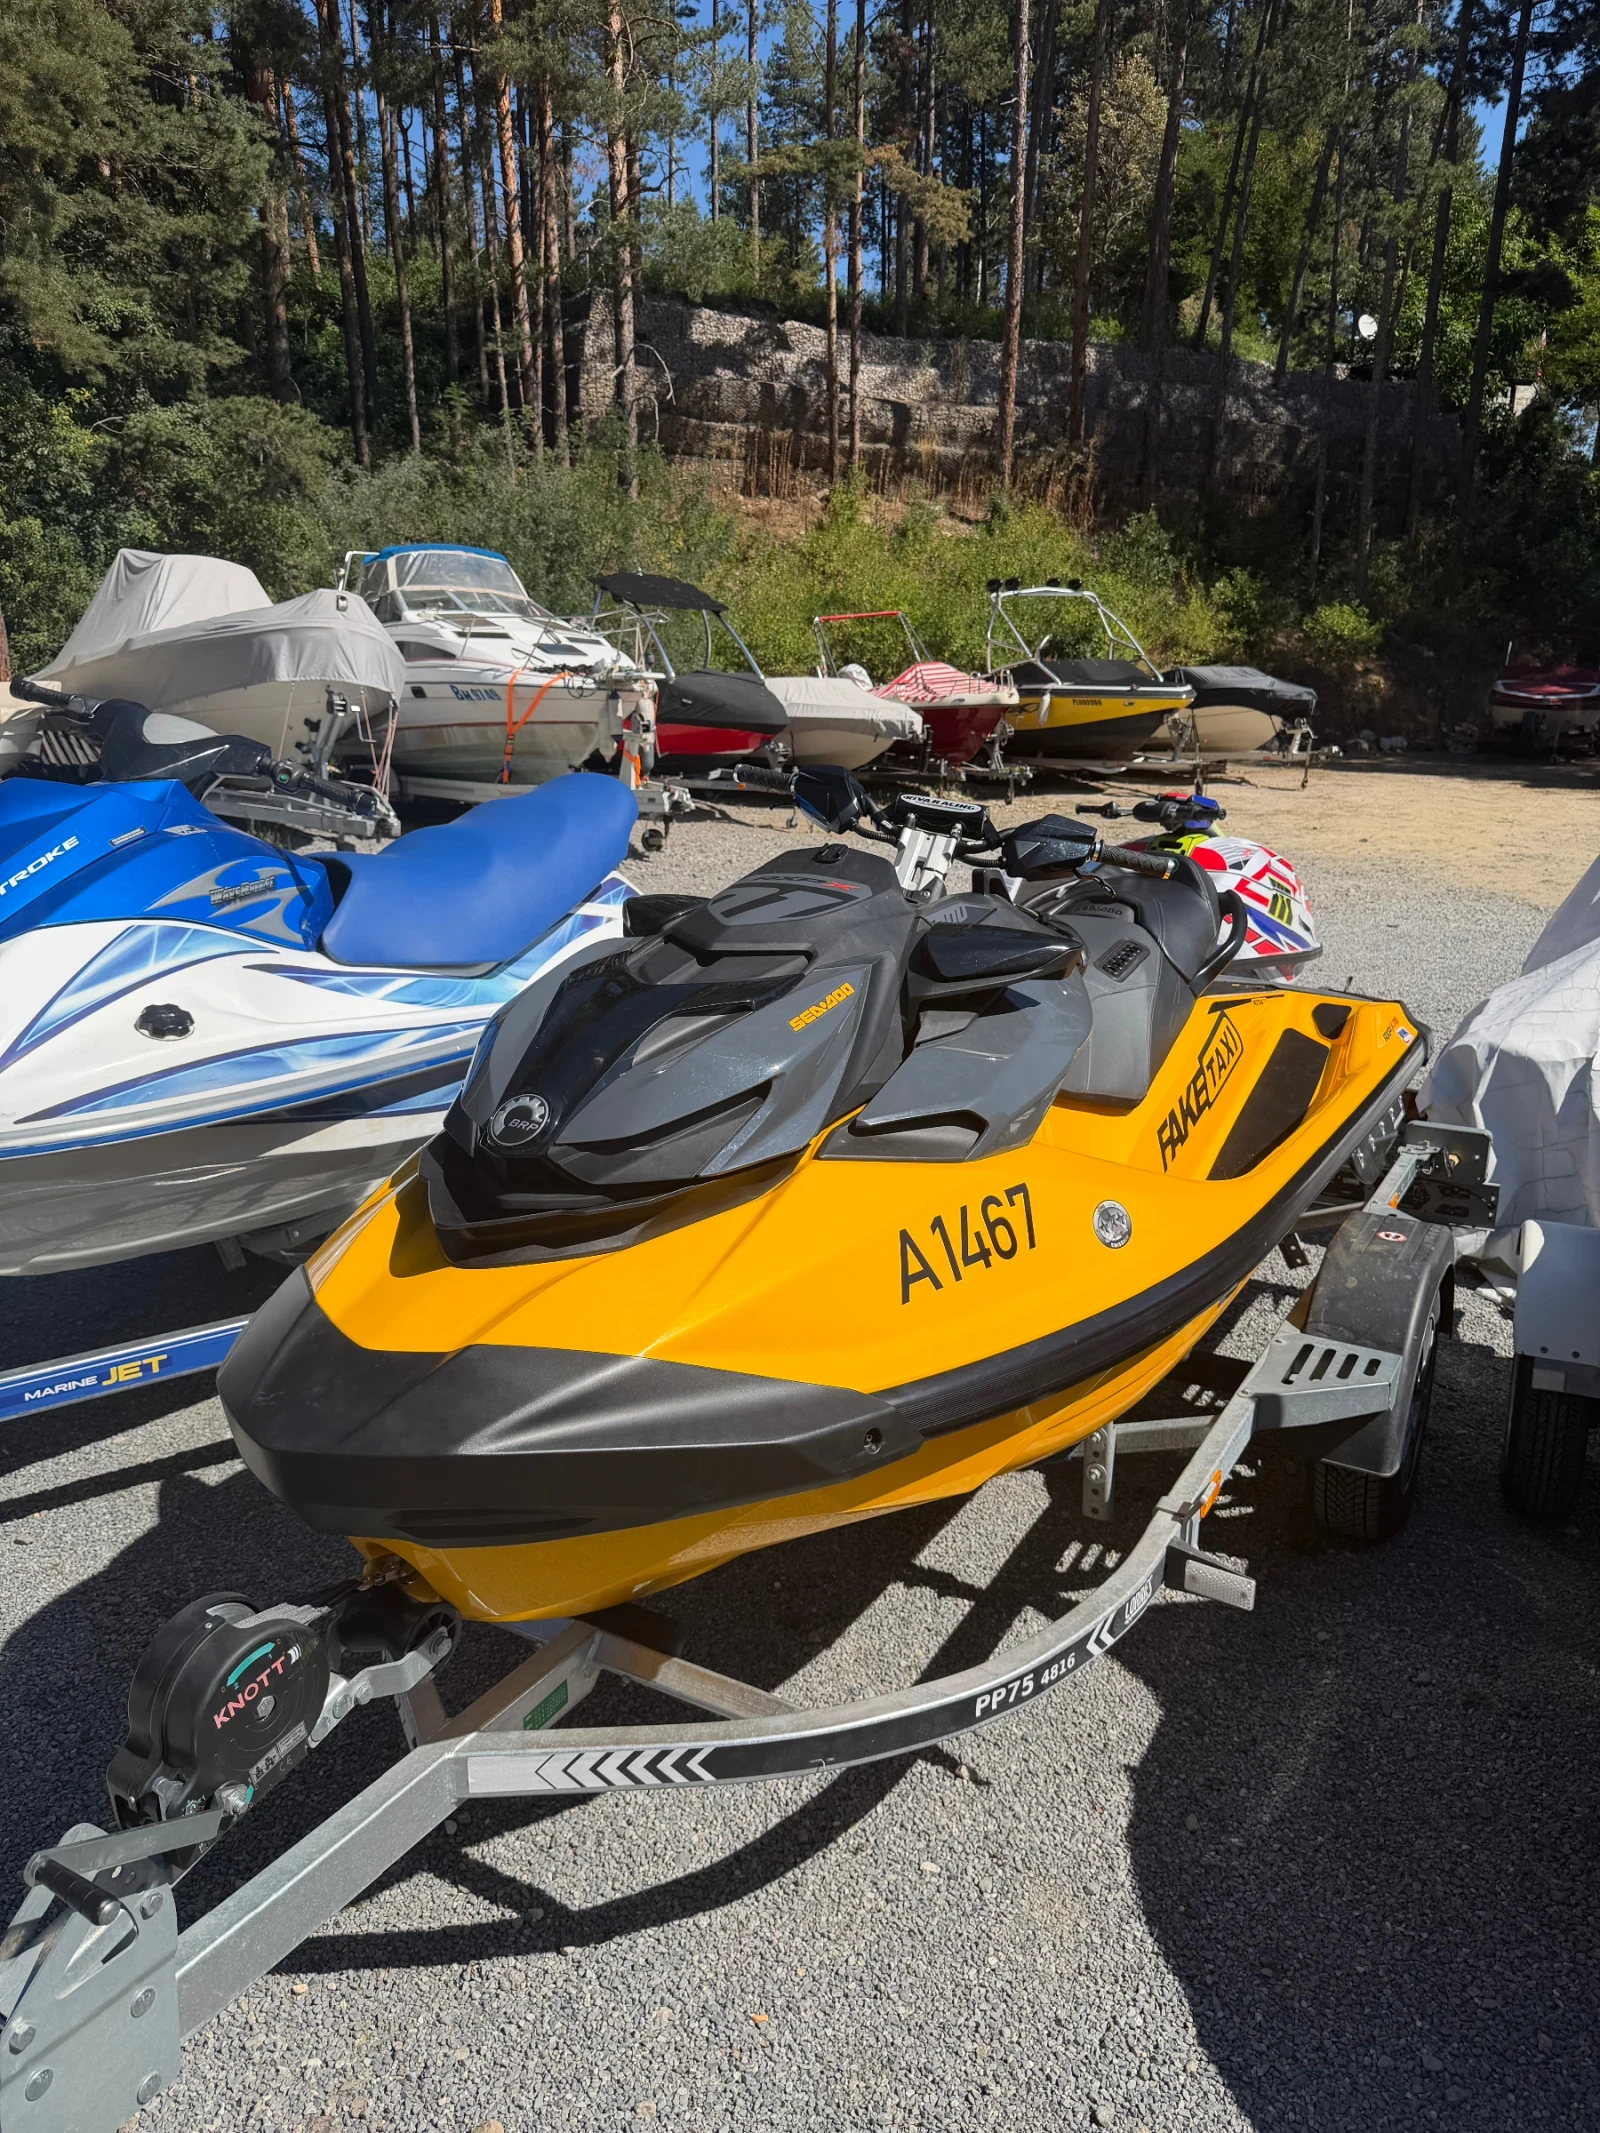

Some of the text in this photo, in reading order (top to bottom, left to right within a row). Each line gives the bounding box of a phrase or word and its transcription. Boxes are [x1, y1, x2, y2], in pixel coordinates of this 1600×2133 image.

[508, 1118, 539, 1131] BRP
[1157, 1025, 1238, 1174] FAKE TAXI
[24, 1354, 168, 1402] MARINE JET
[213, 1655, 285, 1730] KNOTT
[975, 1652, 1076, 1718] PP75 4816
